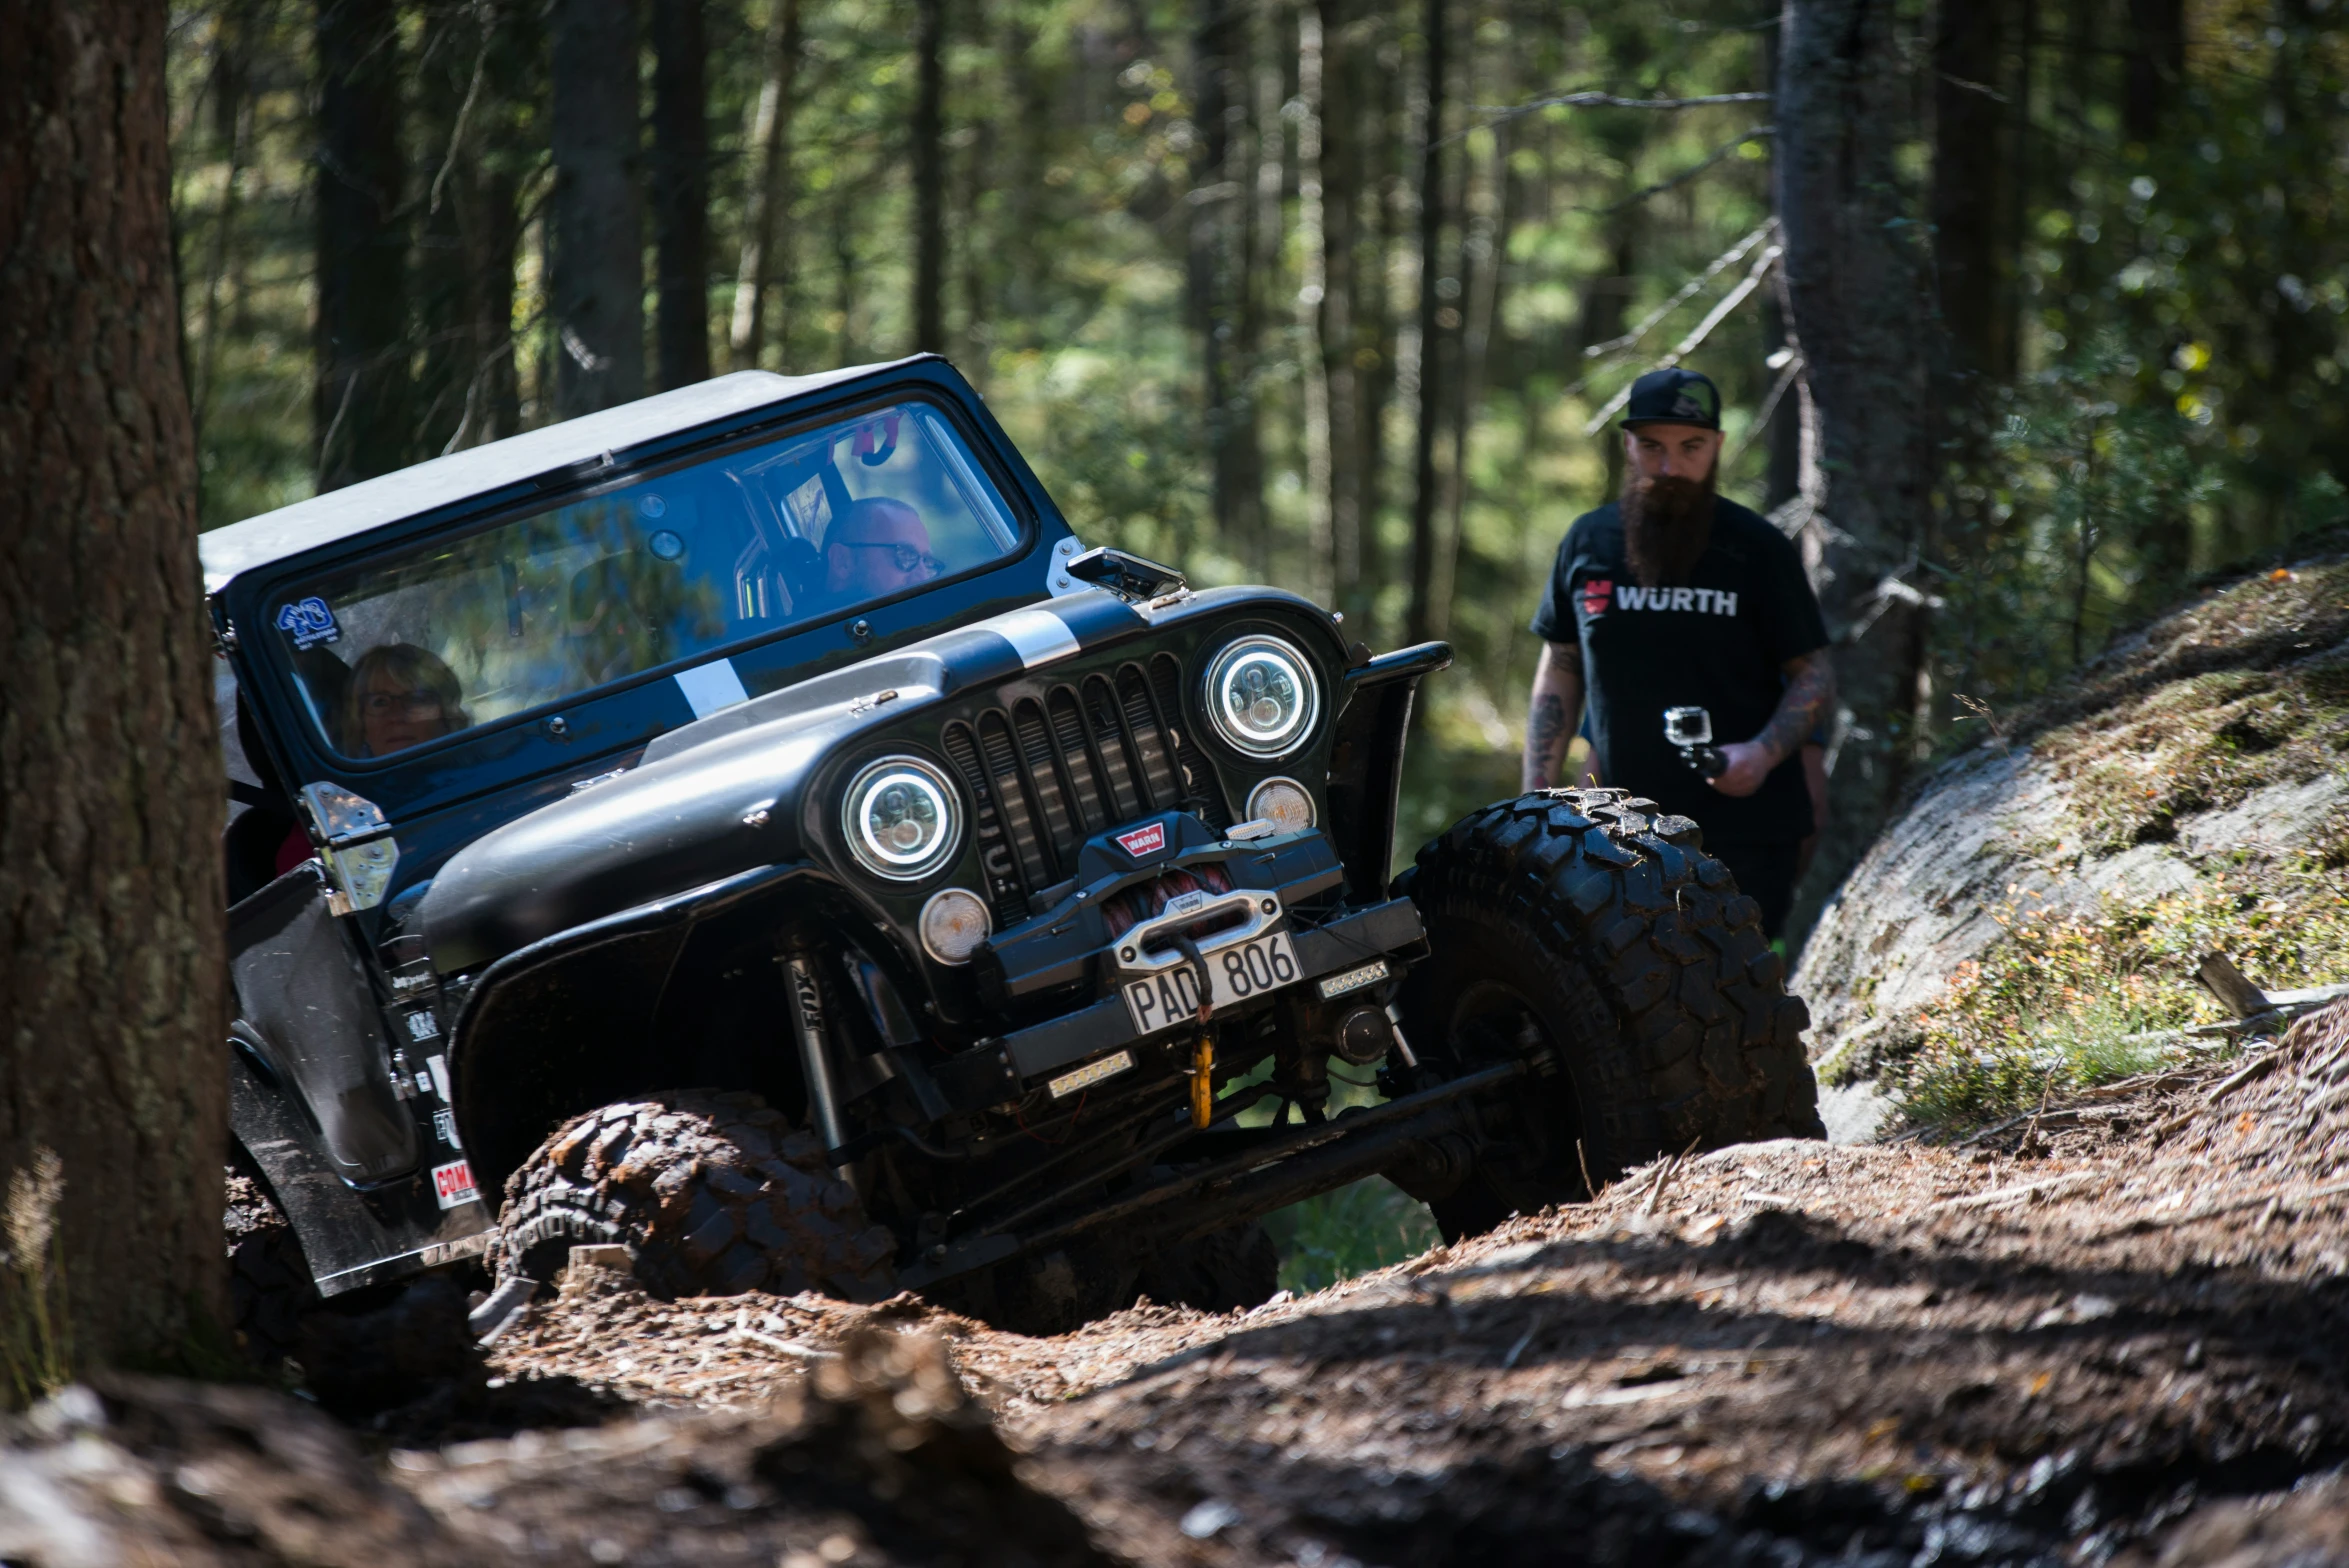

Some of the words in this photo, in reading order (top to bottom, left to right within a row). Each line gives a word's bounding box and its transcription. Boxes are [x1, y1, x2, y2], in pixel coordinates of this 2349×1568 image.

[1616, 586, 1738, 616] WÜRTH
[1127, 832, 1160, 851] WARN
[1130, 969, 1199, 1030] PAD
[1223, 936, 1295, 997] 806
